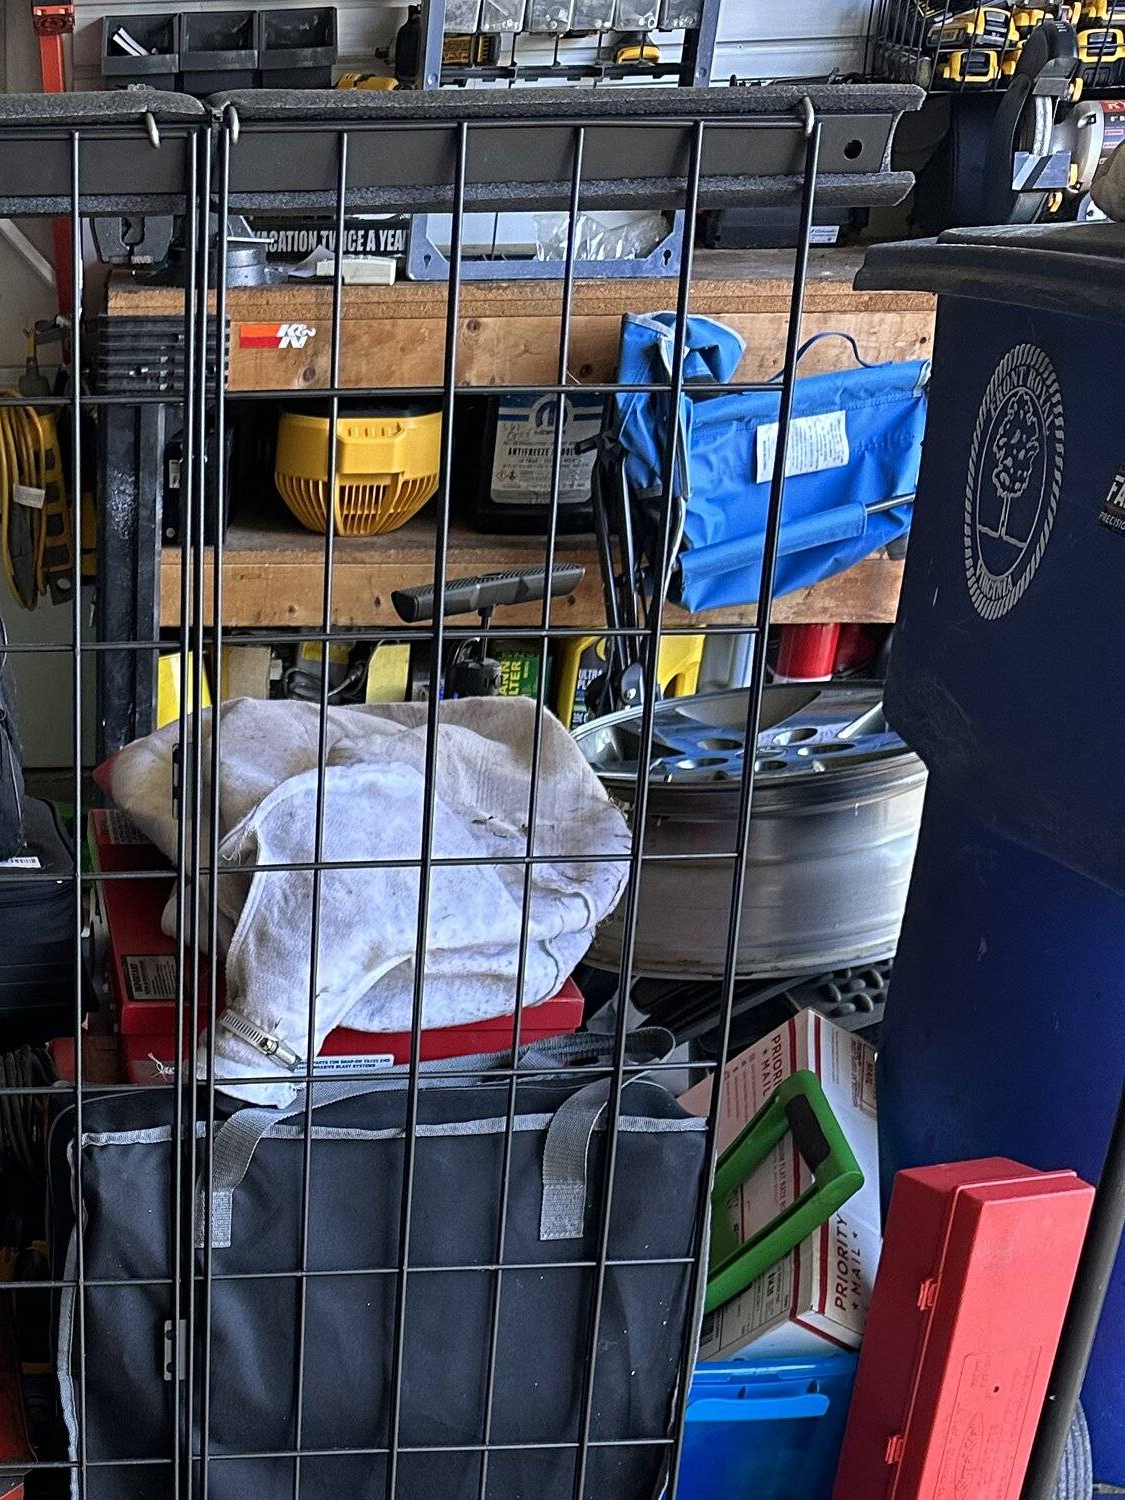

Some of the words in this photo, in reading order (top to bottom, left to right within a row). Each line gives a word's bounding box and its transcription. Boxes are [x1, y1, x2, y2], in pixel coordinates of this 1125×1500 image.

[366, 230, 375, 251] A
[276, 324, 316, 349] K&N
[771, 1034, 783, 1087] PRIORI
[834, 1212, 849, 1311] PRIORITY
[851, 1247, 861, 1296] MAIL
